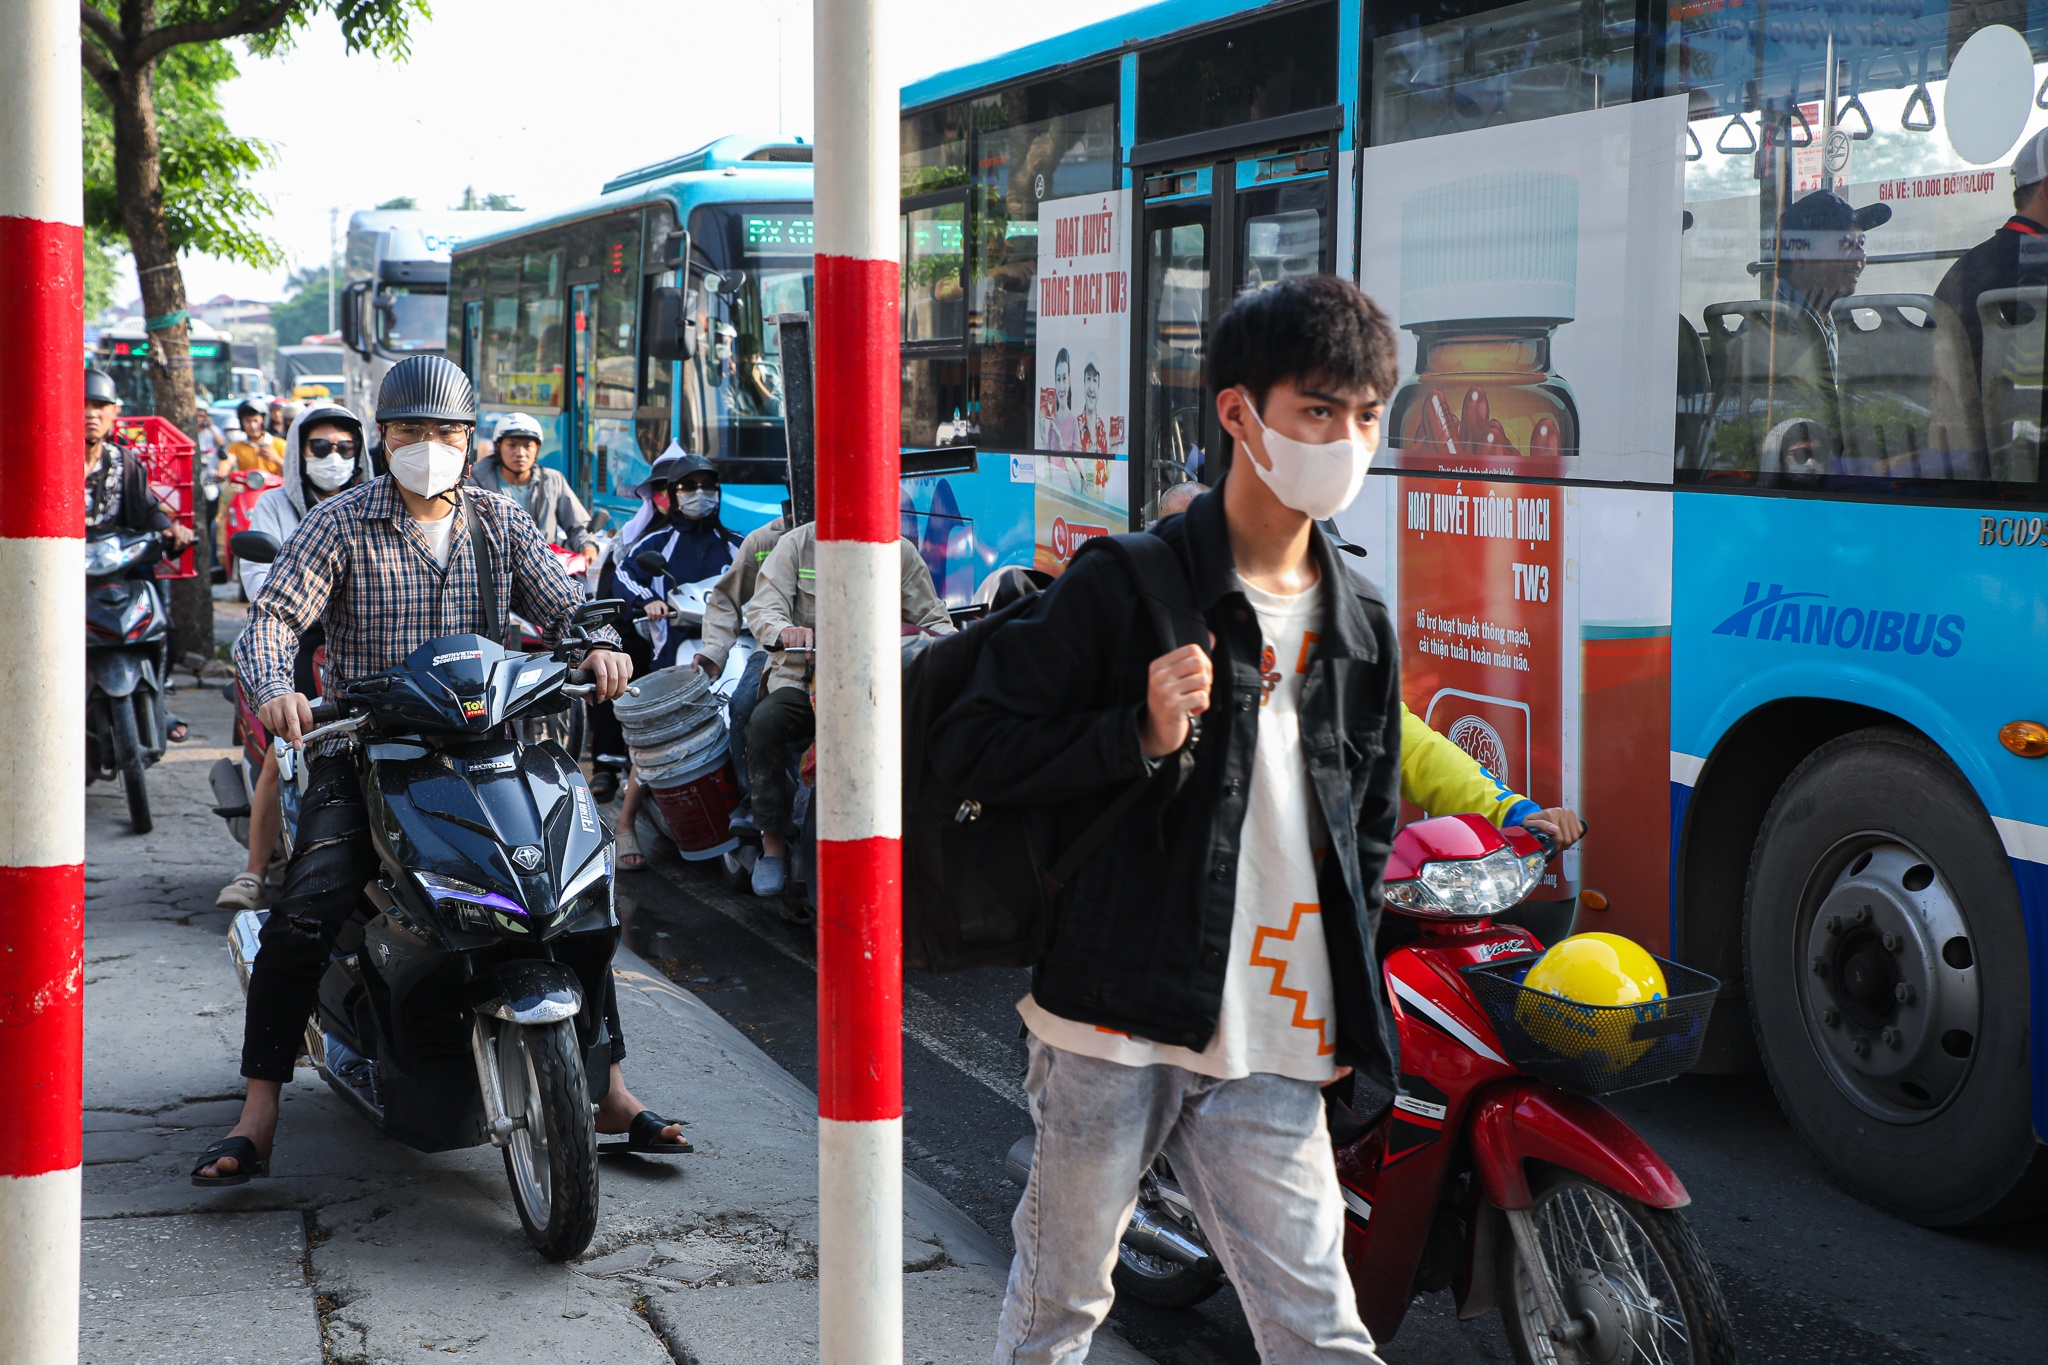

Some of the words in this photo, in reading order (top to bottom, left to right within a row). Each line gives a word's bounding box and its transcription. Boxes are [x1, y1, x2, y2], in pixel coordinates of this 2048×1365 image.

[1879, 179, 1894, 201] GIÁ
[1912, 178, 1941, 198] 10.000
[1055, 215, 1080, 267] HOẠT
[1082, 198, 1113, 256] HUYẾT
[1040, 269, 1070, 317] THÔNG
[1073, 273, 1102, 325] MẠCH
[1105, 271, 1127, 313] TW3
[1407, 491, 1431, 540] HOẠT
[1433, 482, 1469, 535] HUYẾT
[1472, 489, 1513, 539] THÔNG
[1517, 497, 1550, 550] MẠCH
[1512, 562, 1550, 603] TW3
[1416, 609, 1426, 628] Hỗ
[1427, 614, 1438, 634] trợ
[1439, 615, 1455, 637] hoạt
[1457, 616, 1480, 639] huyết
[1482, 621, 1505, 645] thông
[1507, 627, 1531, 648] mạch,
[1711, 581, 1965, 658] HANOIBUS
[1419, 635, 1429, 653] cải
[1431, 638, 1448, 659] thiện
[1451, 639, 1469, 661] tuần
[1471, 645, 1491, 665] hoàn
[1494, 649, 1511, 669] máu
[1514, 653, 1530, 671] não.
[469, 761, 513, 771] HONDA
[1477, 939, 1524, 961] Wave
